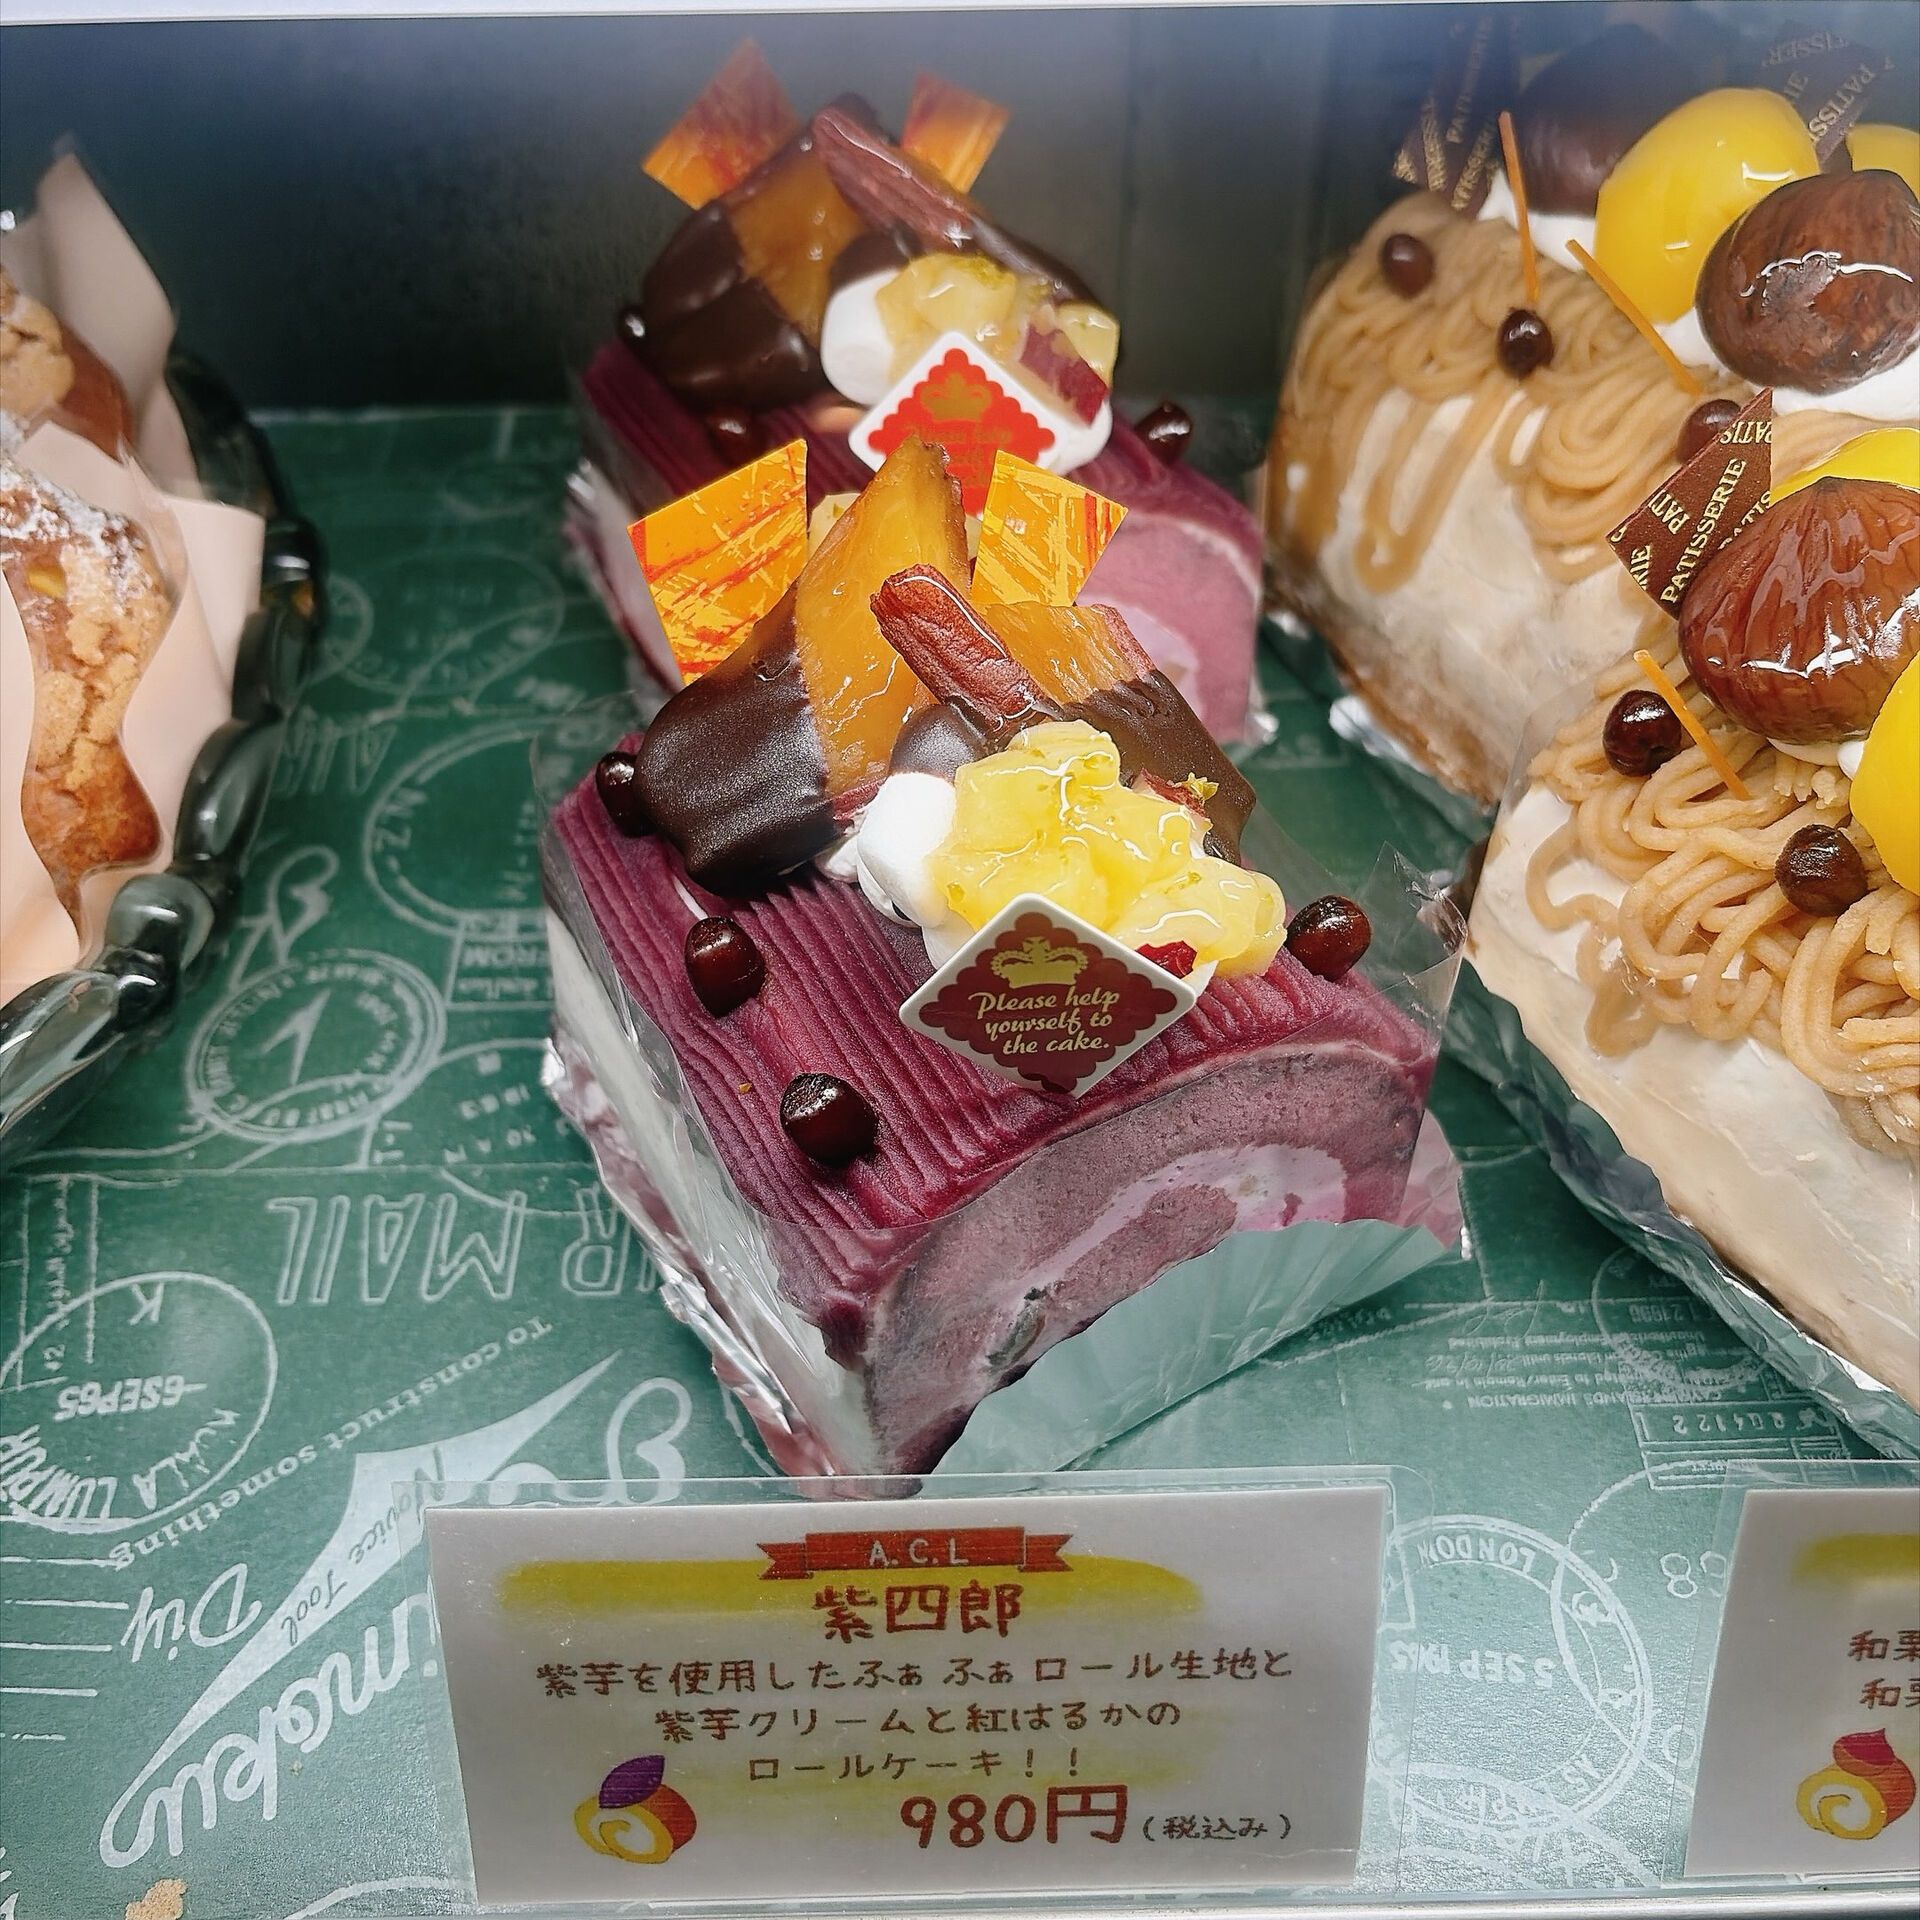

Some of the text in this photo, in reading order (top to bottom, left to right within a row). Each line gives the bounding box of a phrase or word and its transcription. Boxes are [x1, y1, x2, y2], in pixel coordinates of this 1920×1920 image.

[1660, 457, 1747, 604] PATISSERIE
[968, 986, 1121, 1019] Please help
[985, 1011, 1114, 1041] yourself to
[1003, 1032, 1110, 1056] the cake.
[266, 1190, 529, 1306] MAIL
[129, 1281, 166, 1326] K
[506, 1315, 553, 1349] To
[324, 1341, 502, 1452] construct
[1467, 1393, 1577, 1409] IMMIGRATION
[106, 1443, 317, 1571] something
[869, 1537, 969, 1567] A.C.L
[1417, 1533, 1536, 1574] LONDON
[121, 1563, 262, 1663] Diy
[812, 1578, 1025, 1644] 紫四郎
[1459, 1651, 1526, 1684] SEP
[654, 1702, 1182, 1744] 紫芋クリームと紅はるかの
[900, 1784, 1129, 1849] 980円
